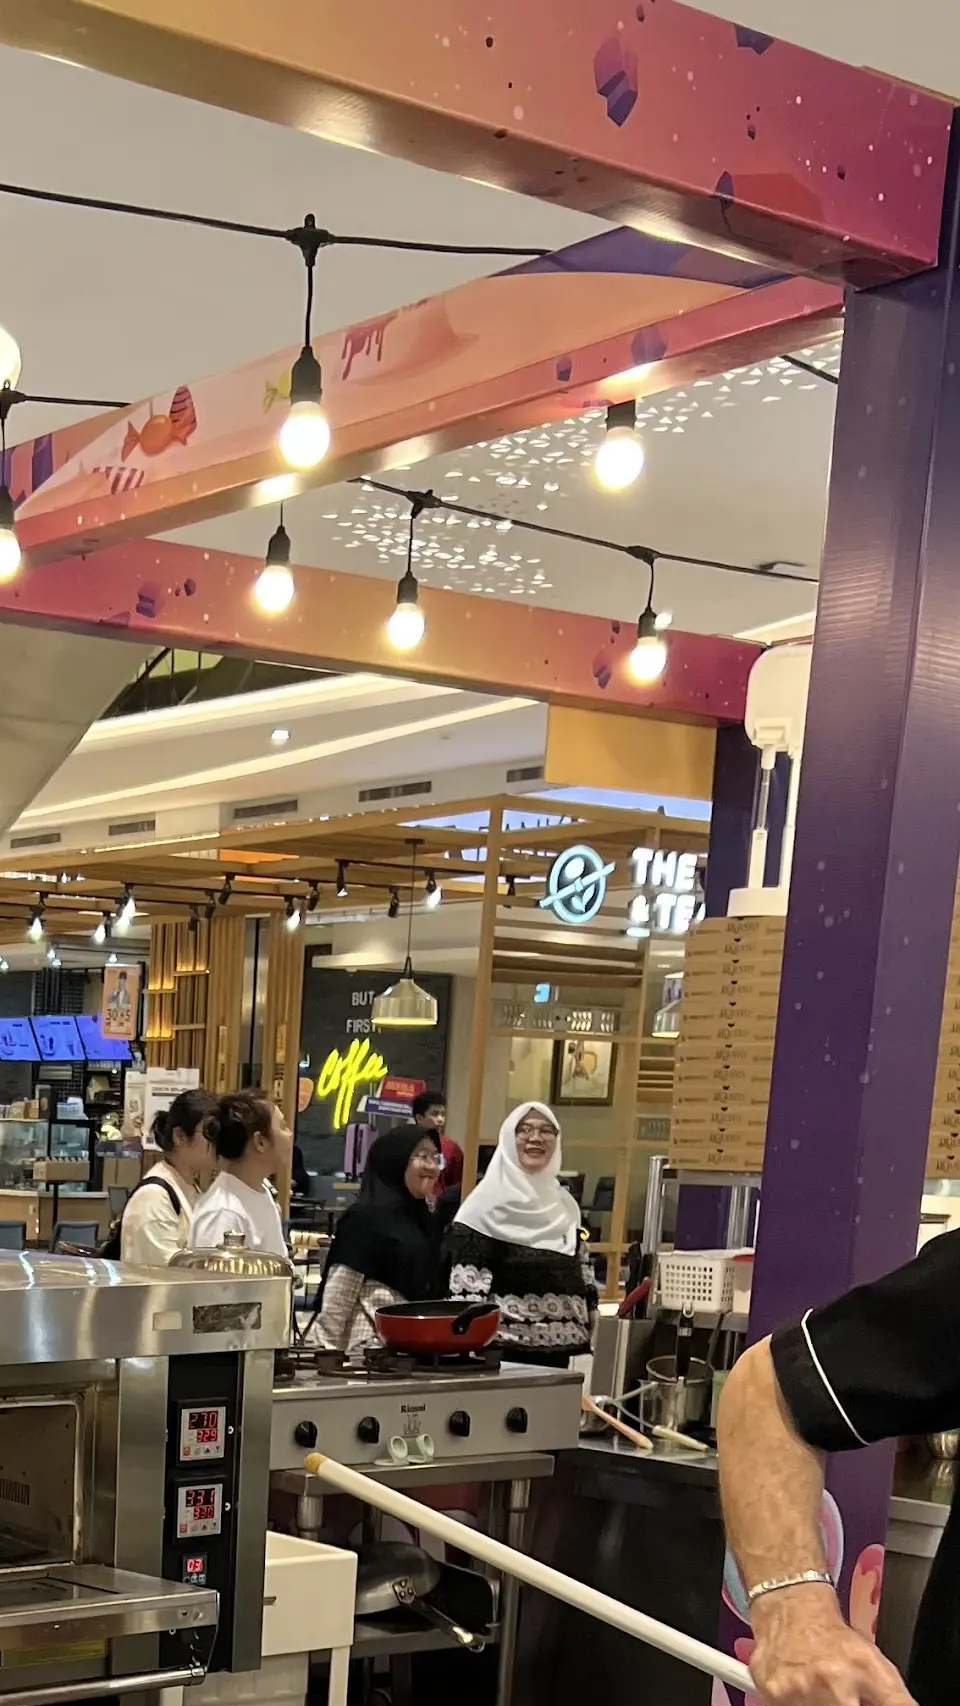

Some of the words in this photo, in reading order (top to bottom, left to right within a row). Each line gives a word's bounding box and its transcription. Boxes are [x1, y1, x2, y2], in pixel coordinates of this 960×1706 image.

[632, 847, 697, 890] THE
[655, 893, 706, 932] TE
[351, 991, 376, 1006] BUT
[190, 1411, 218, 1429] 270
